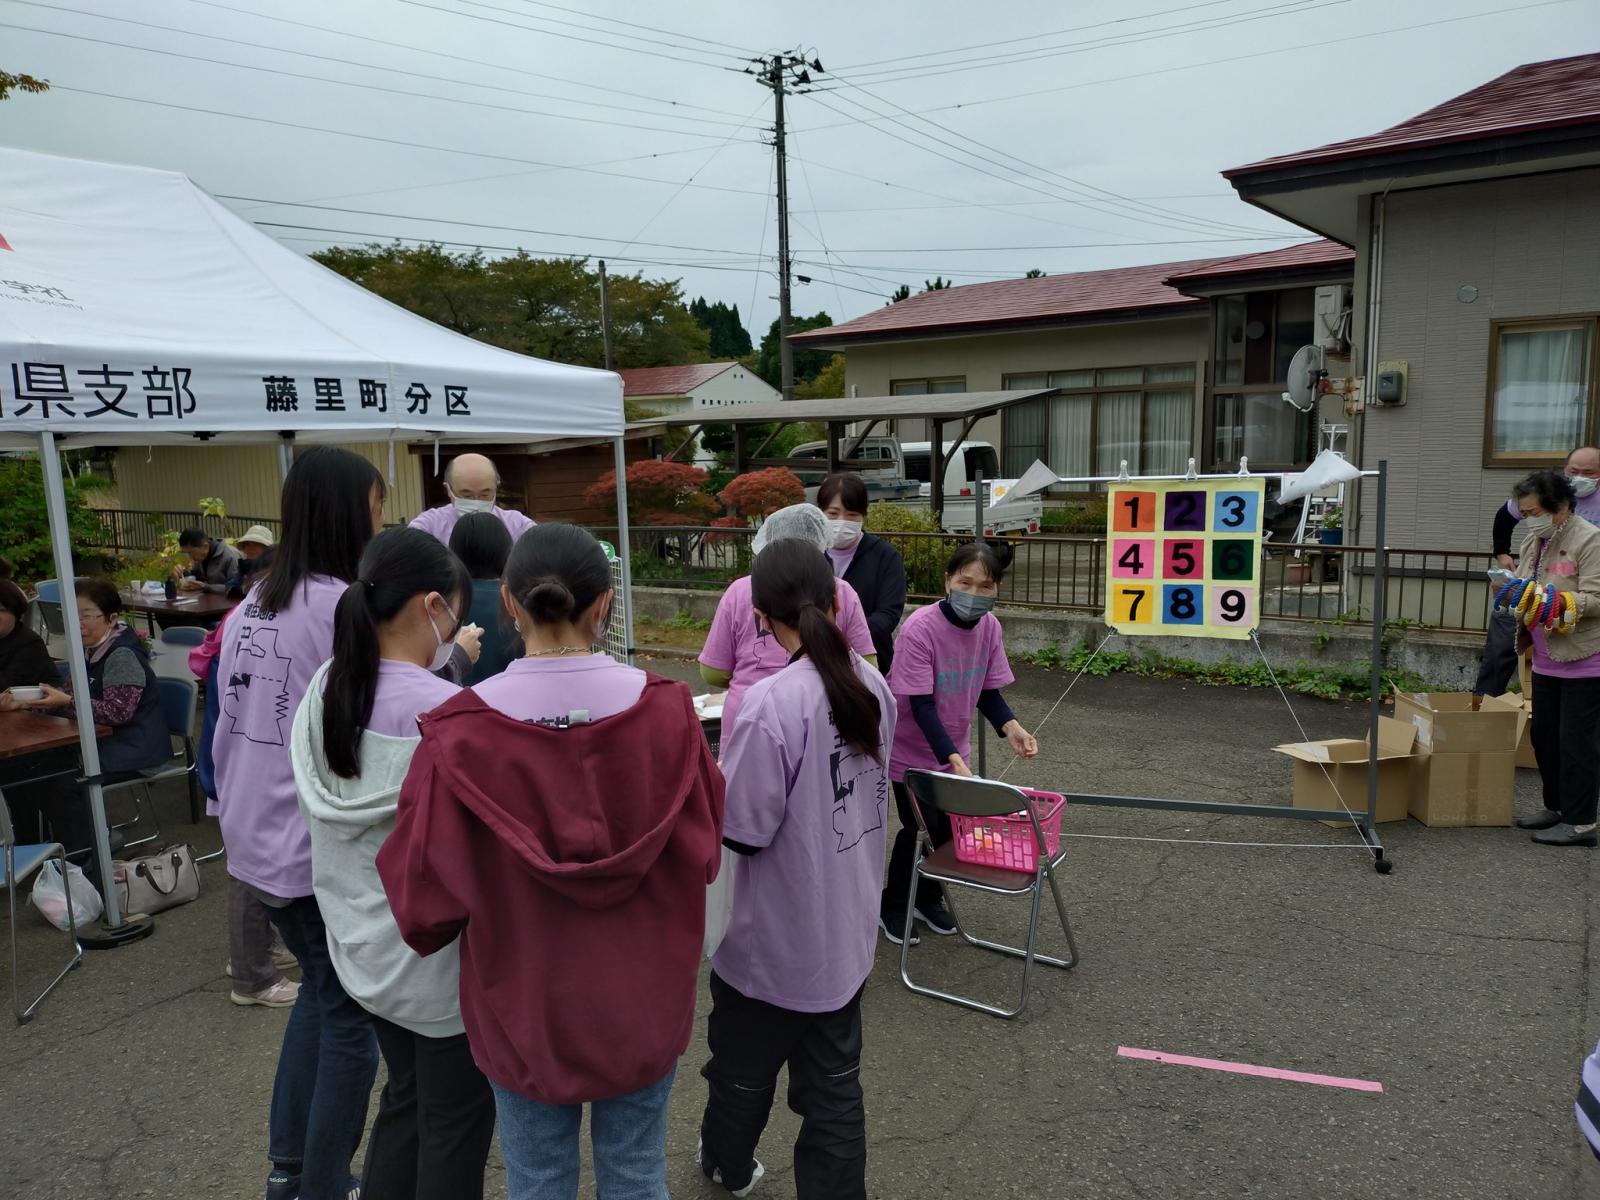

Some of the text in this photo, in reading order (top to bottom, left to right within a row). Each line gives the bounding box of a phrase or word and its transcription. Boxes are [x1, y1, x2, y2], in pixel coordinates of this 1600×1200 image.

[0, 362, 471, 419] 県支部 藤里町分区
[1124, 494, 1246, 529] 1 2 3
[1118, 542, 1246, 575] 4 5 6
[1122, 588, 1246, 622] 7 8 9
